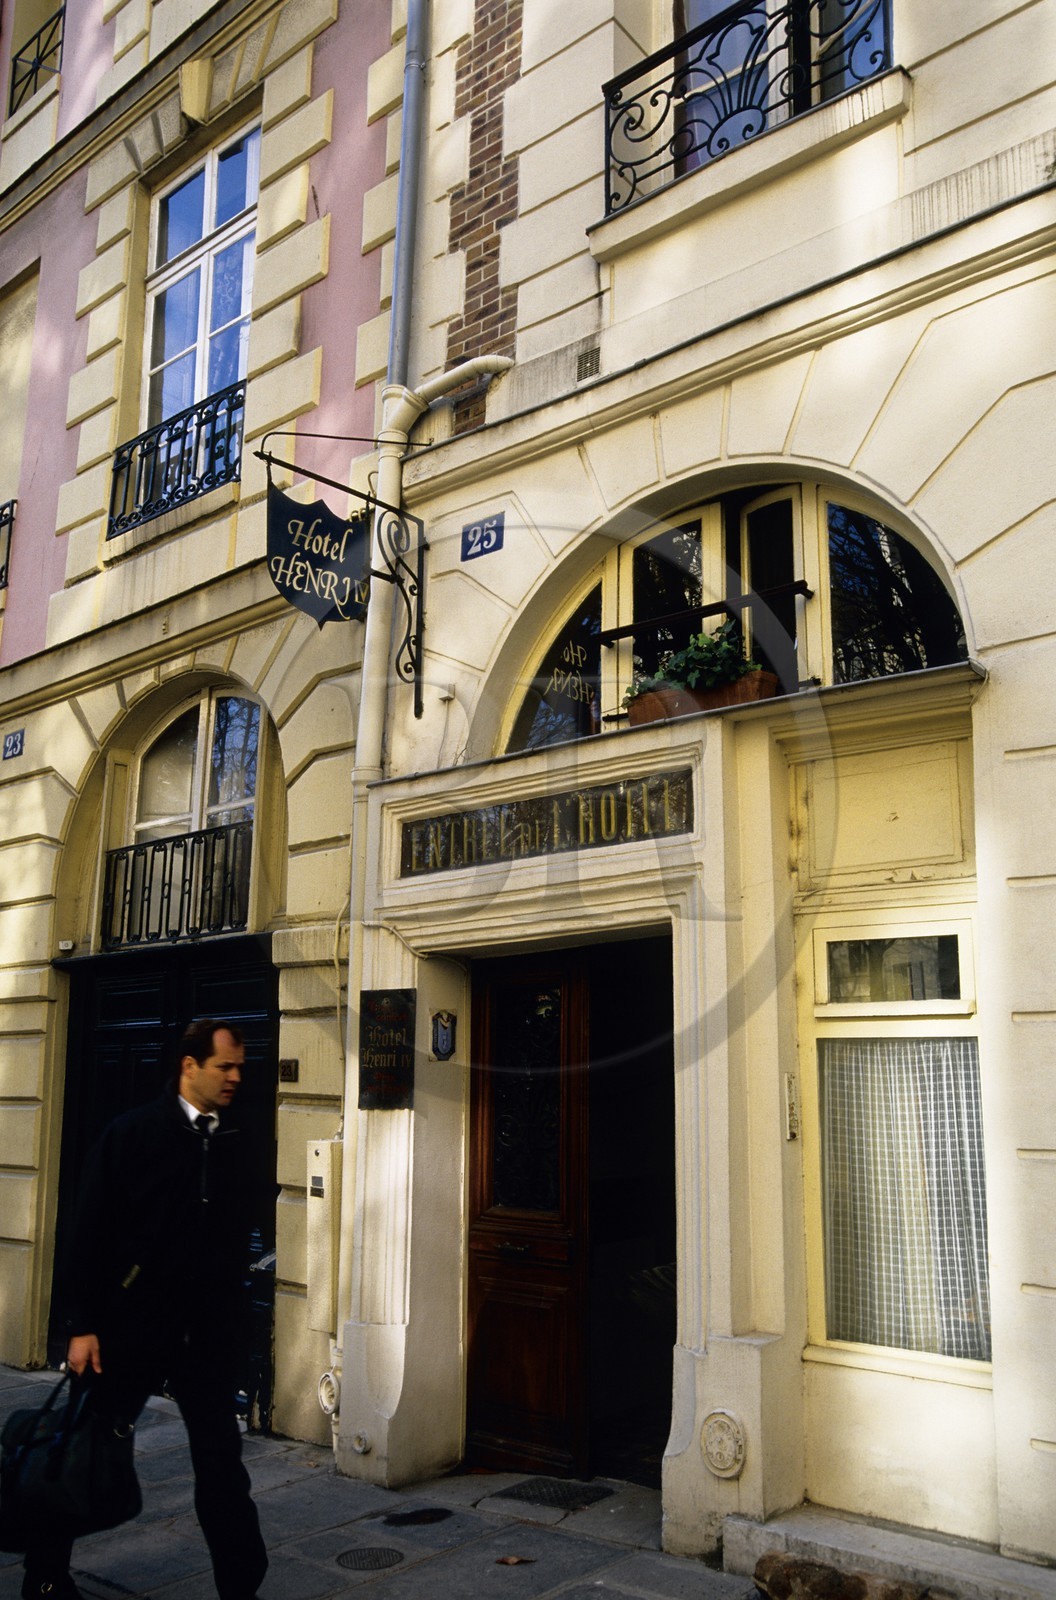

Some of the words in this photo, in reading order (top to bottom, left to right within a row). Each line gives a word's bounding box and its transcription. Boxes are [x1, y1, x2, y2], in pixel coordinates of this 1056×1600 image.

[287, 518, 353, 563] Hotel
[466, 519, 497, 556] 25
[270, 551, 350, 620] HENRI
[4, 733, 22, 759] 23
[365, 1025, 408, 1047] Hotel
[281, 1064, 292, 1077] 23
[361, 1047, 396, 1069] Henri
